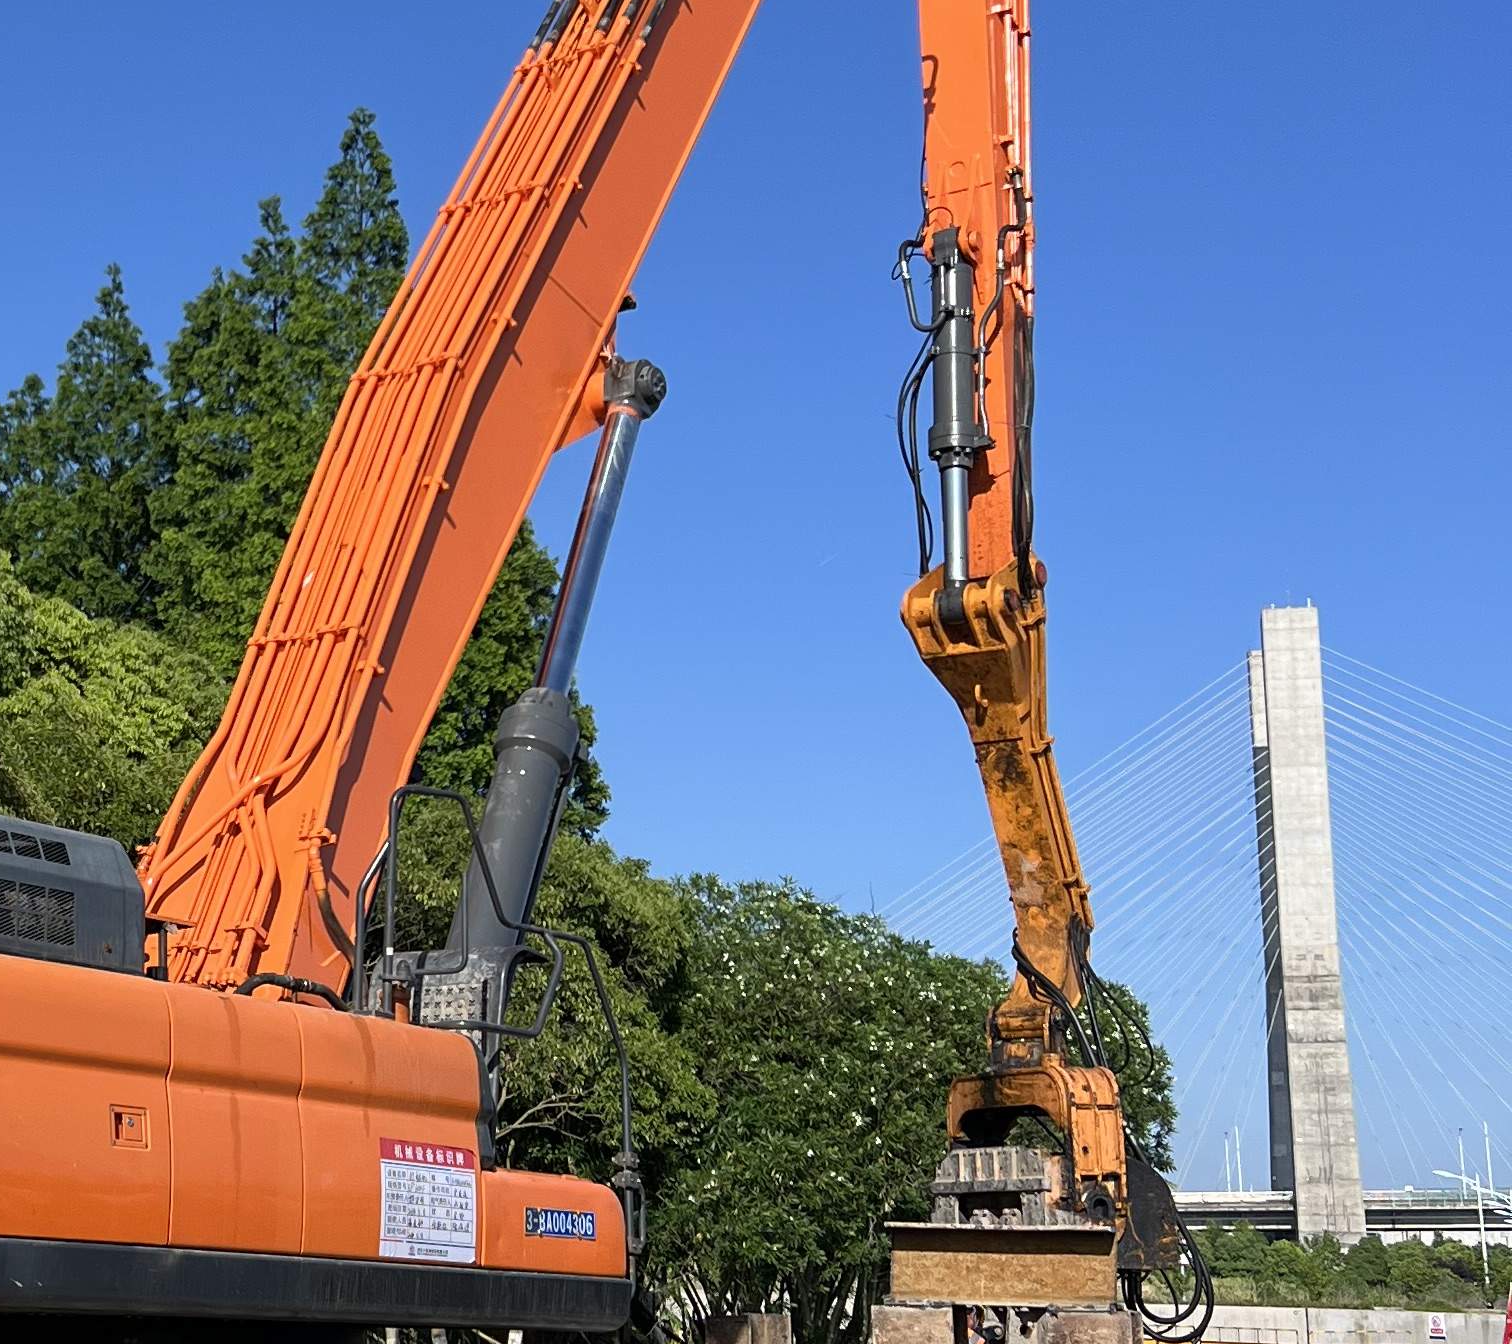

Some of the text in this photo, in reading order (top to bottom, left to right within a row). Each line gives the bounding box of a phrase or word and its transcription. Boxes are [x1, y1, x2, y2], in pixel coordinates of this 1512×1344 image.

[394, 1143, 465, 1166] 机械设备标识牌
[526, 1210, 593, 1236] 3-BA004306
